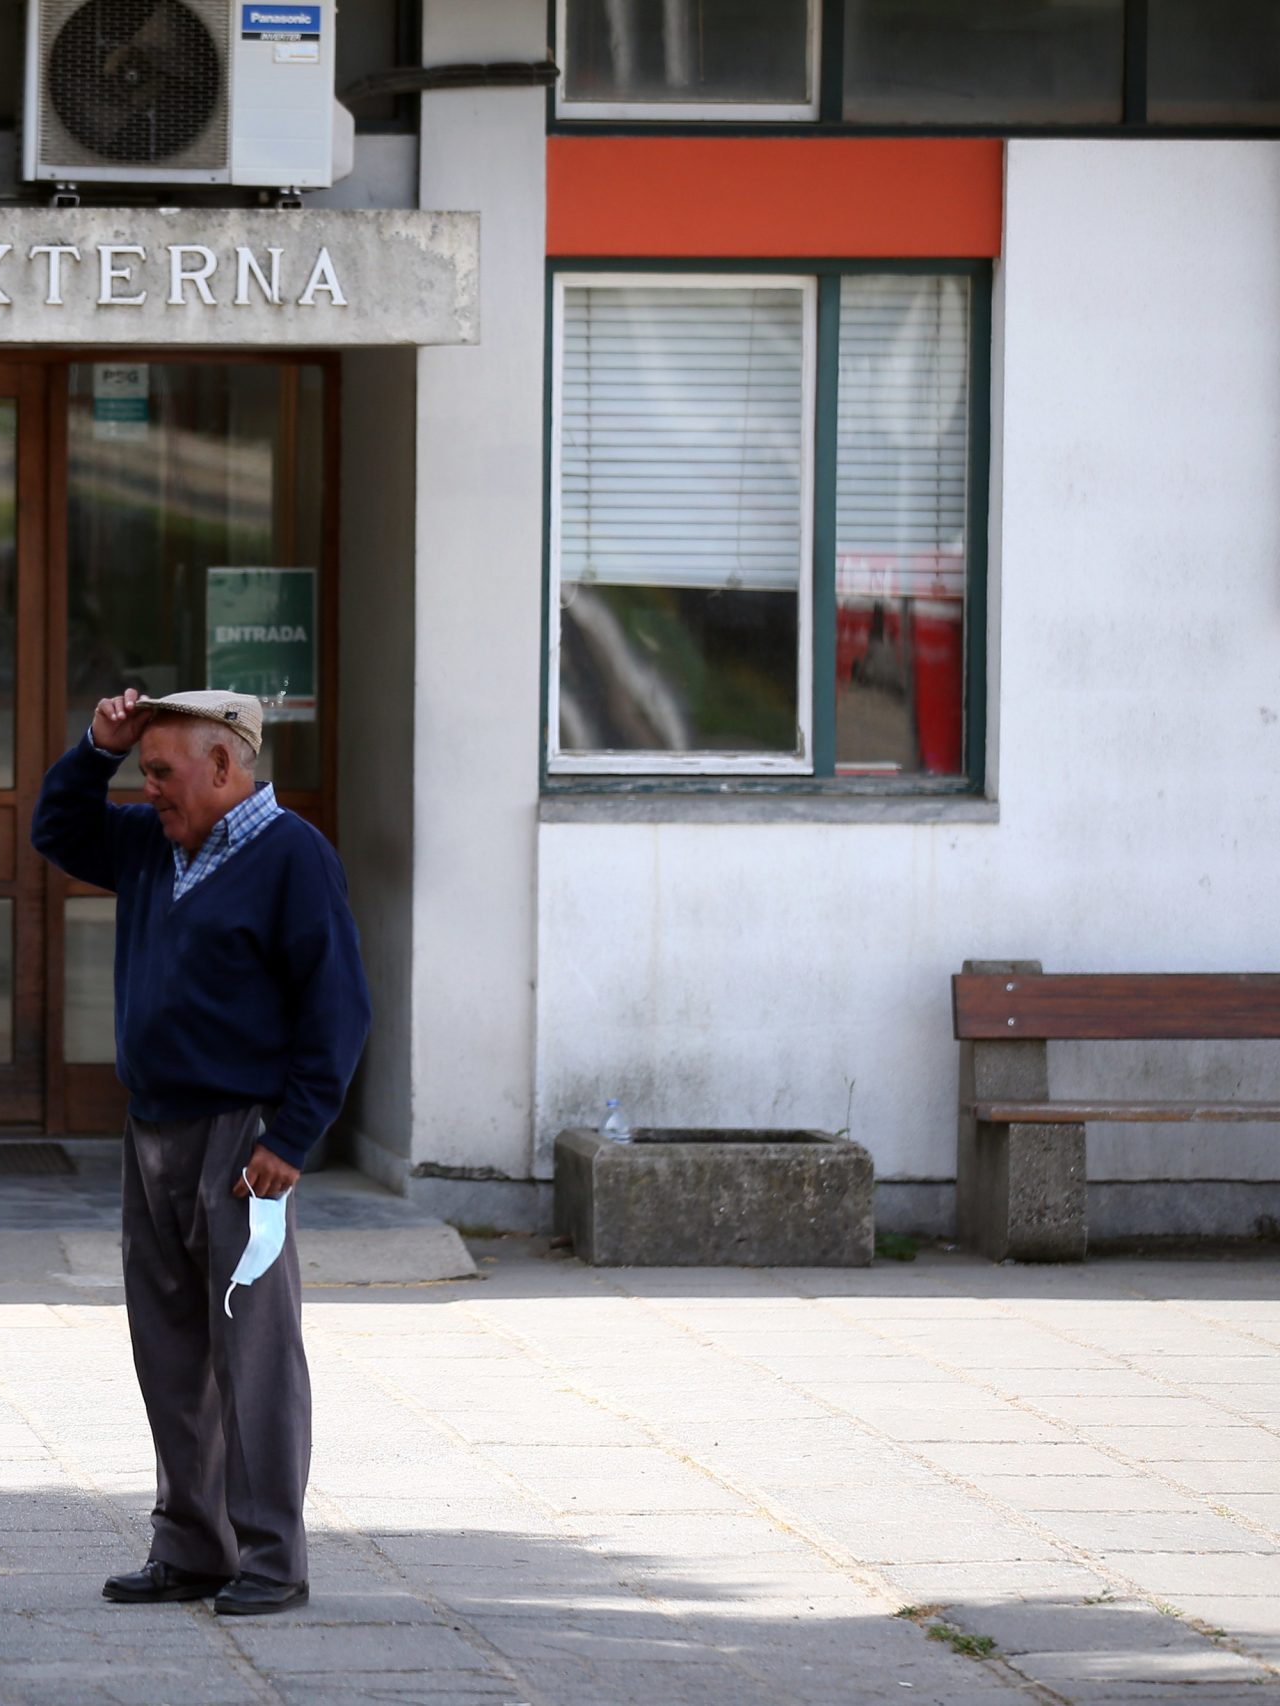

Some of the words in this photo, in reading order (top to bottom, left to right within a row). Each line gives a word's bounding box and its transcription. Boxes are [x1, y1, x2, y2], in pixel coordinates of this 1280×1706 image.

[250, 11, 312, 25] Panasonic
[260, 33, 302, 41] INVERTER
[214, 625, 308, 643] ENTRADA
